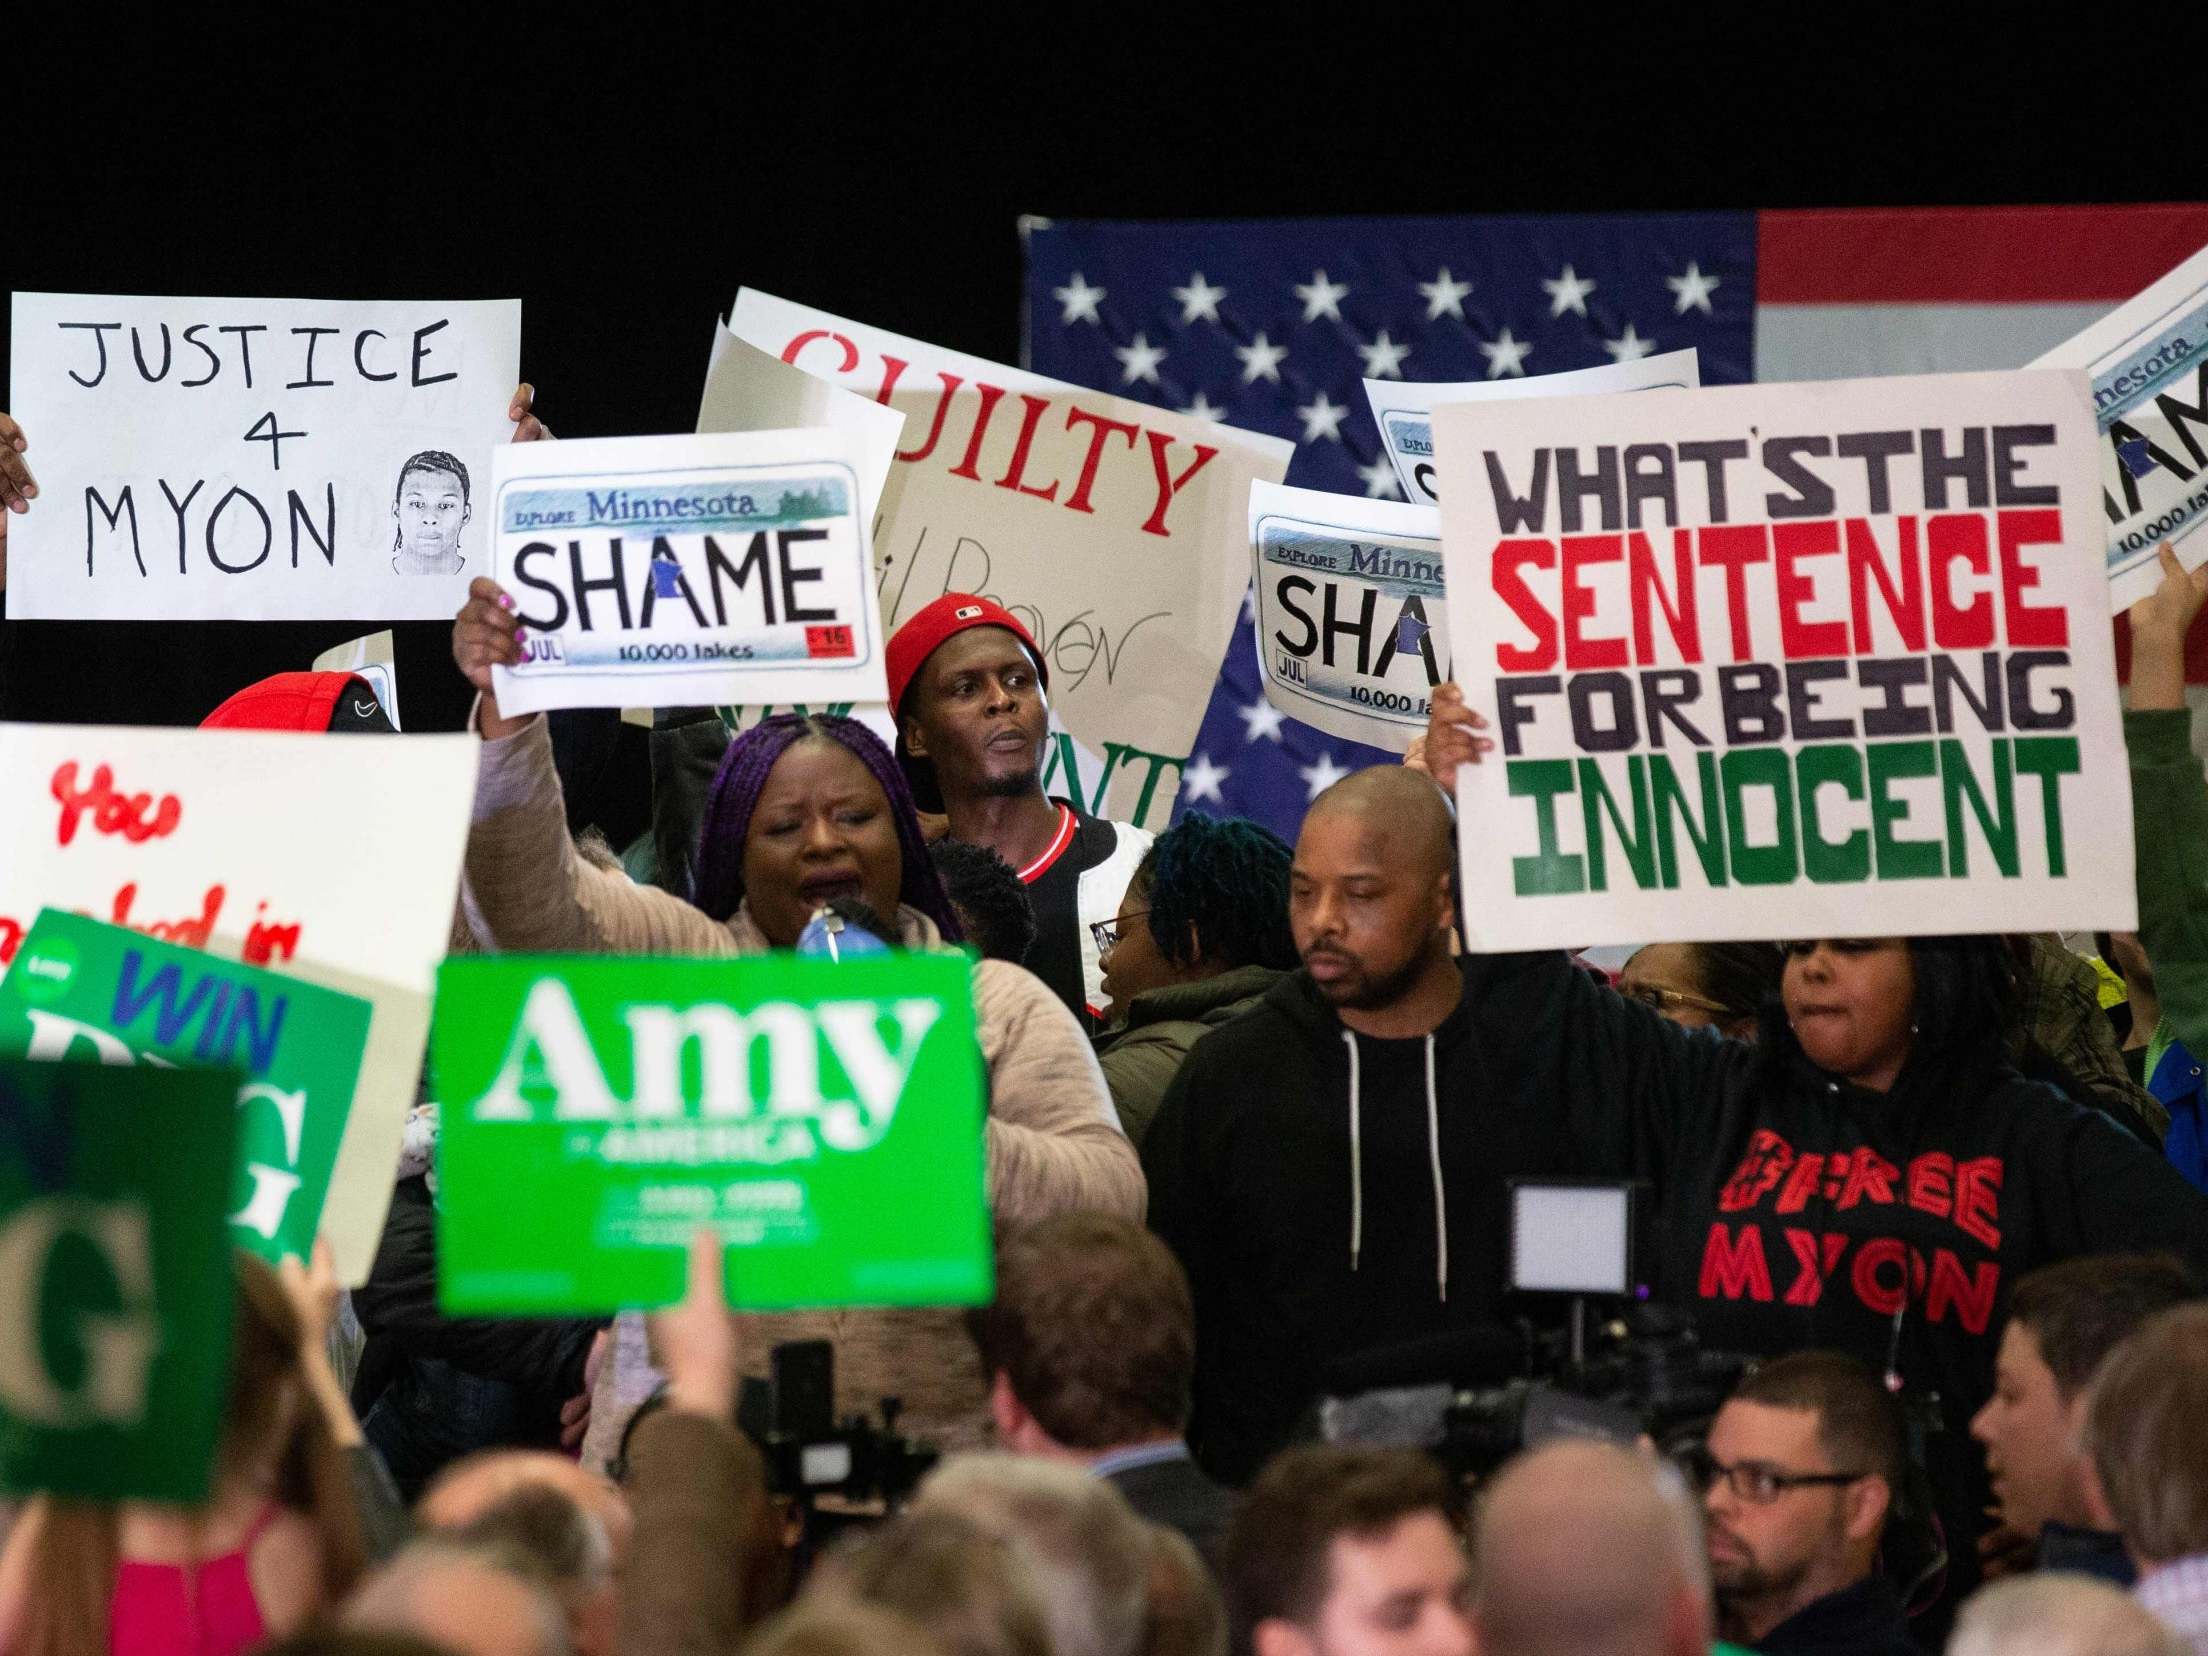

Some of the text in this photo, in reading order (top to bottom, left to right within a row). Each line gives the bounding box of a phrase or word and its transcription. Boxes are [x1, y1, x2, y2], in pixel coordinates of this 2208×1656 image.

[58, 318, 458, 390] JUSTICE
[243, 411, 308, 471] 4
[85, 478, 337, 578] MYON
[515, 489, 759, 527] EXPLORE Minnesota
[1278, 545, 1337, 569] EXPLORE
[513, 528, 838, 634] SHAME
[1275, 574, 1453, 688] SHA
[1490, 508, 2070, 673] SENTENCE
[527, 638, 562, 663] JUL
[694, 642, 755, 659] lakes
[1279, 656, 1305, 684] JUL
[1495, 650, 2080, 756] FOR BEING
[1505, 736, 2080, 896] INNOCENT
[112, 950, 289, 1078] WIN
[472, 976, 941, 1151] Amy
[1698, 1222, 2001, 1335] MYON
